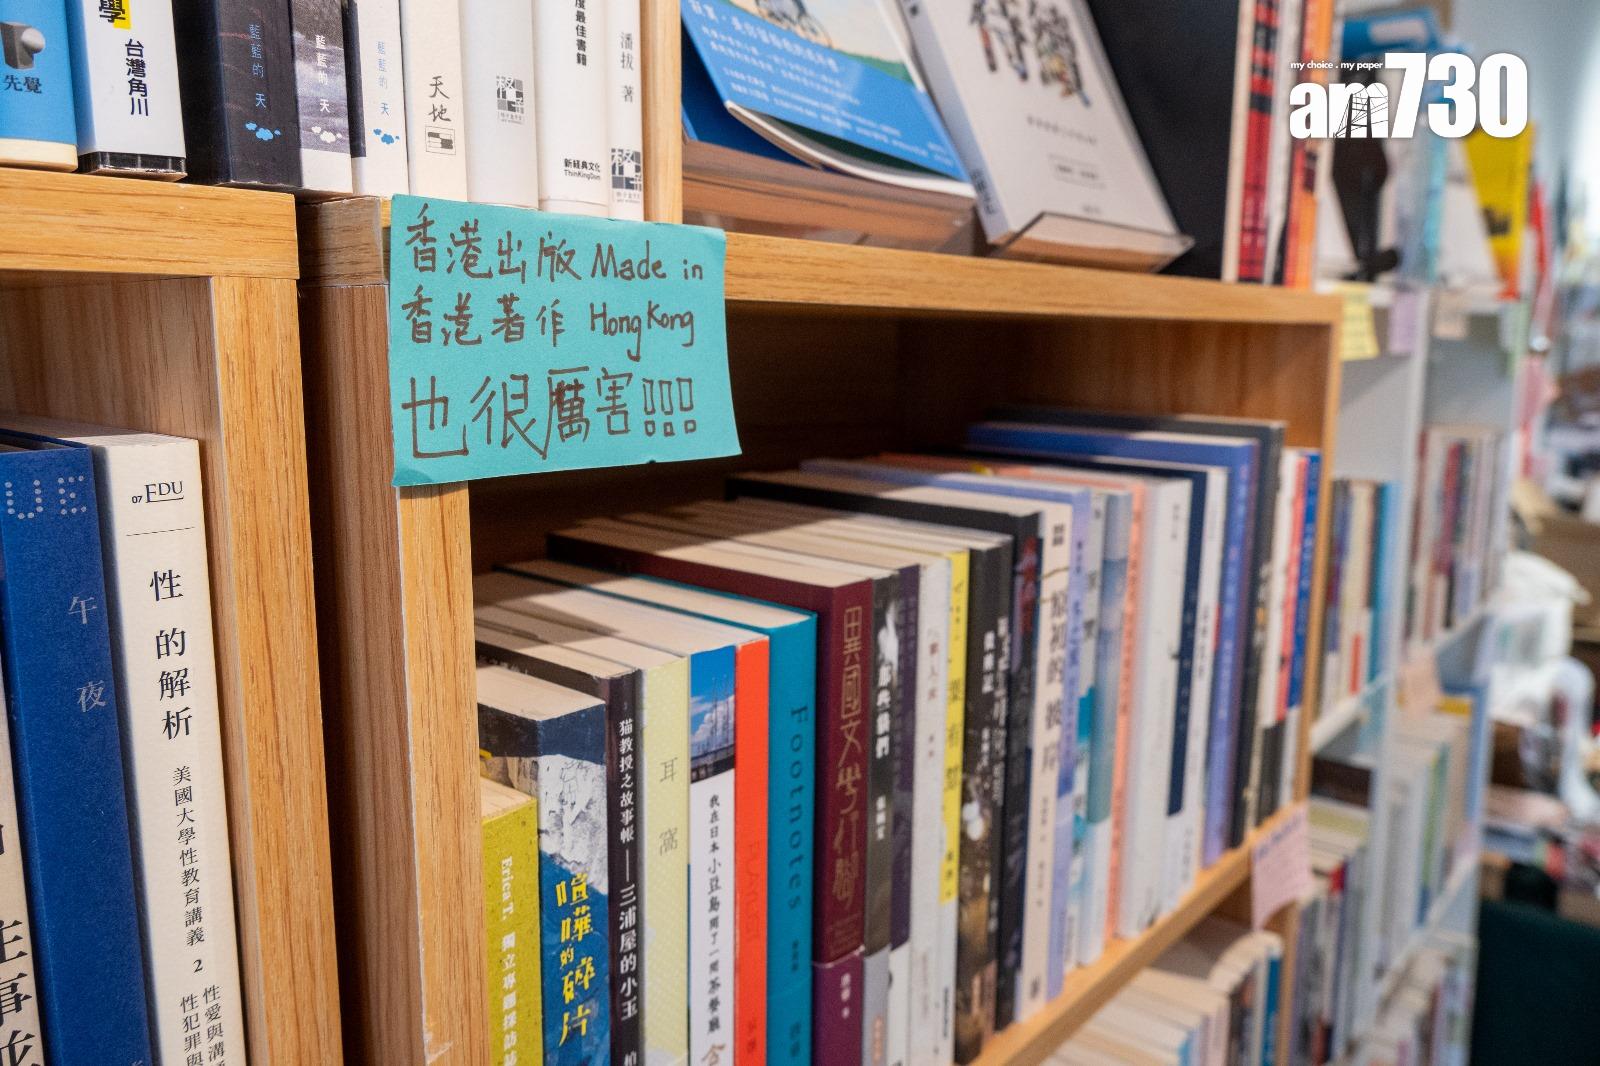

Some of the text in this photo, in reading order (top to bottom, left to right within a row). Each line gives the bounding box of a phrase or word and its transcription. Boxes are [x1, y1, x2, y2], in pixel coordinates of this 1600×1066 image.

[3, 74, 42, 95] 先覺
[125, 38, 149, 117] 台灣角川
[428, 75, 452, 123] 天地
[405, 203, 582, 284] 香港出版
[591, 240, 704, 281] Made in
[402, 285, 566, 347] 香港著作
[131, 480, 184, 504] 07 EDU
[68, 597, 106, 713] 午夜
[150, 569, 192, 740] 性的解析
[659, 757, 679, 856] 耳窩
[788, 705, 809, 911] Footnotes
[173, 765, 205, 973] 美國大學性教育講義 2
[502, 856, 514, 902] Erica
